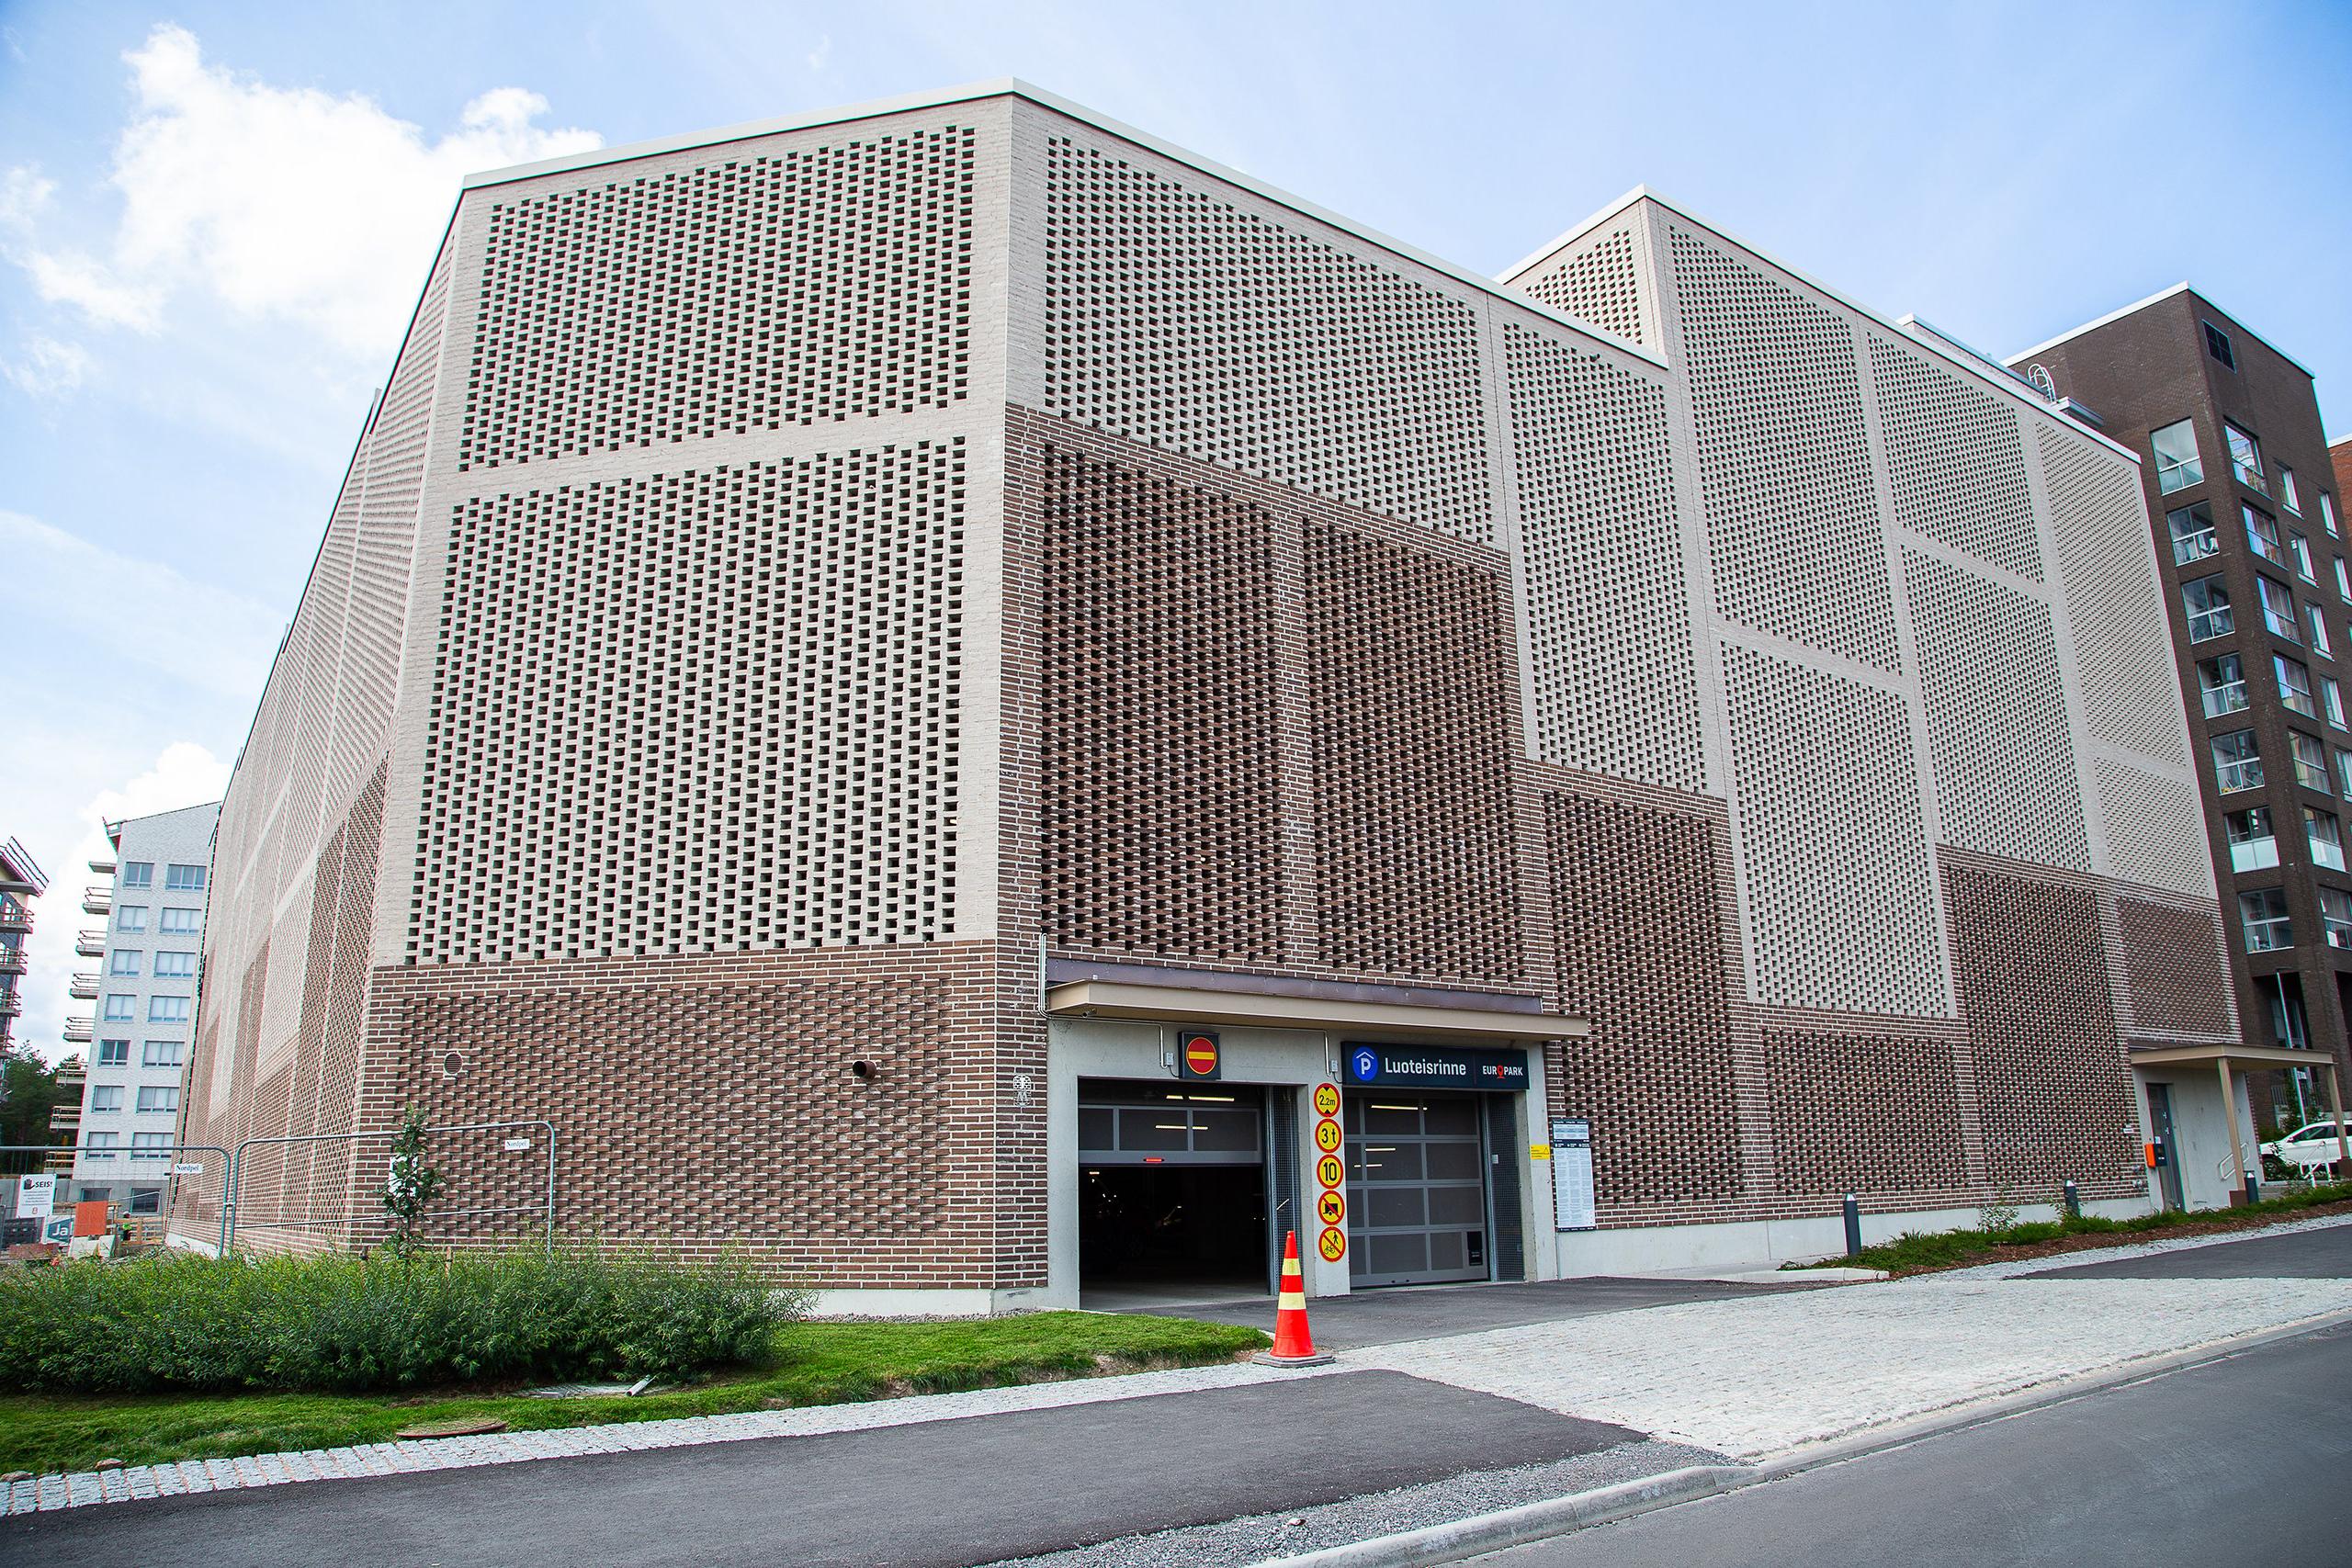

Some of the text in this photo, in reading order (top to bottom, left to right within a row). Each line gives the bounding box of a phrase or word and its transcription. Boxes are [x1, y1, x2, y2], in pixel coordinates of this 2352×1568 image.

[1385, 1057, 1467, 1076] Luoteisrinne
[1482, 1065, 1523, 1078] EUROPARK
[1321, 1128, 1337, 1145] 3 t
[1323, 1162, 1338, 1181] 10
